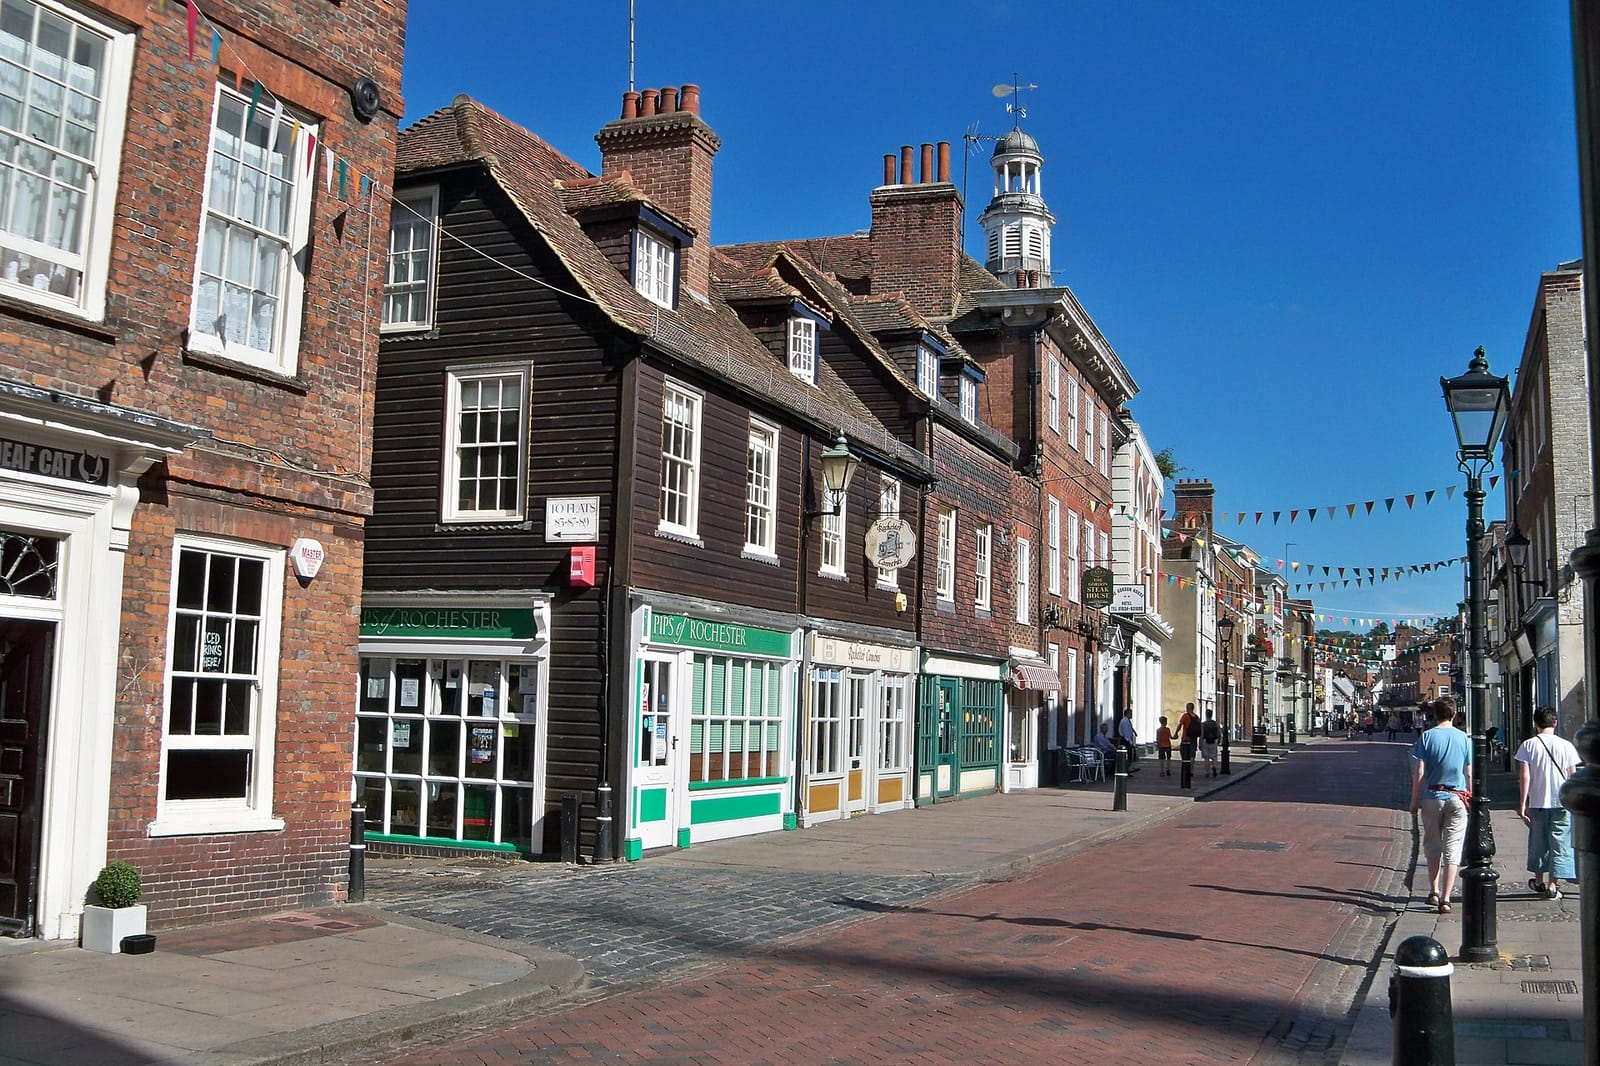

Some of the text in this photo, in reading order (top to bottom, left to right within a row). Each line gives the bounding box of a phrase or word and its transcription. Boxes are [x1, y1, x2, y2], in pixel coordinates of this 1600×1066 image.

[0, 440, 75, 477] EAF CAT
[551, 503, 596, 513] TO FLATS
[301, 547, 322, 559] MASTER
[376, 609, 400, 635] of
[400, 610, 502, 628] ROCHESTER
[653, 614, 746, 646] PIPS of ROCHESTER
[204, 645, 223, 656] RINKS
